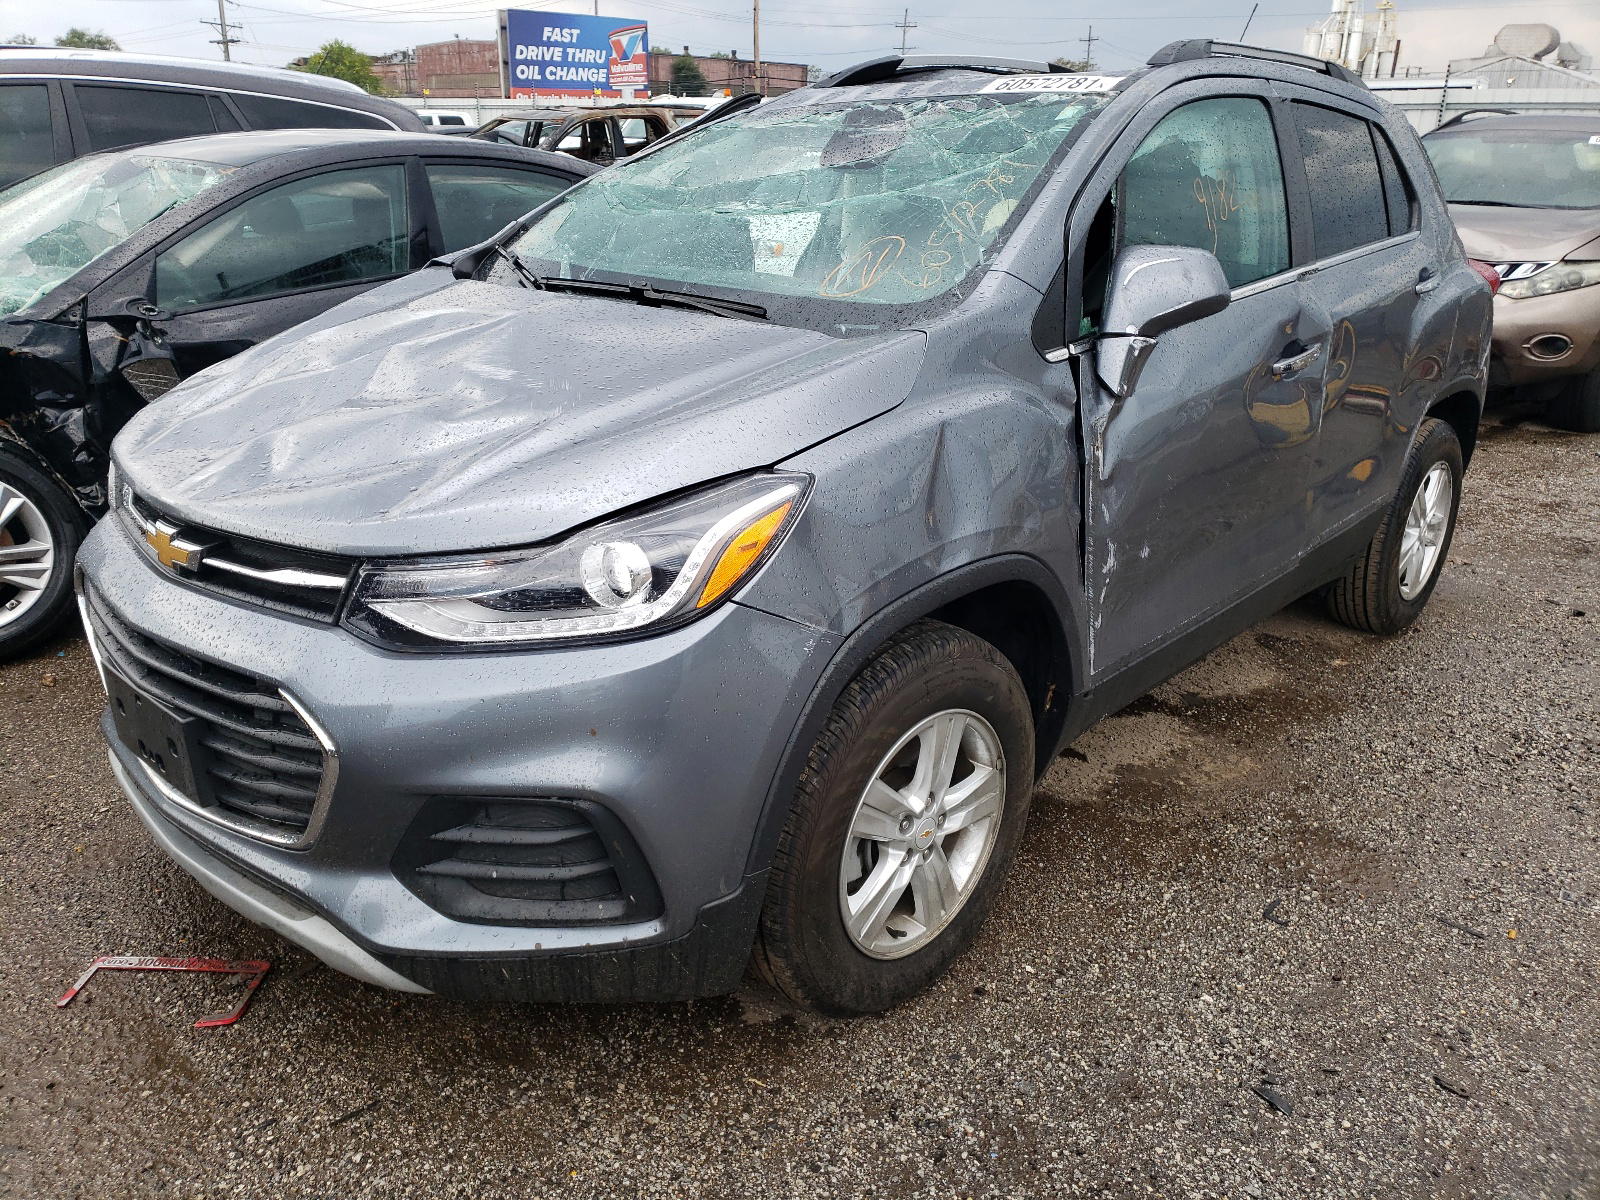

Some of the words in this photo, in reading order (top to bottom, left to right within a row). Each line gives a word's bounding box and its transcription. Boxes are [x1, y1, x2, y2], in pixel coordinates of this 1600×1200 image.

[542, 26, 581, 43] FAST
[515, 44, 563, 61] DRIVE
[567, 47, 607, 64] THRU
[515, 64, 542, 80] OIL
[545, 65, 607, 82] CHANGE
[610, 62, 644, 73] Valvoline
[995, 77, 1101, 91] 60572781
